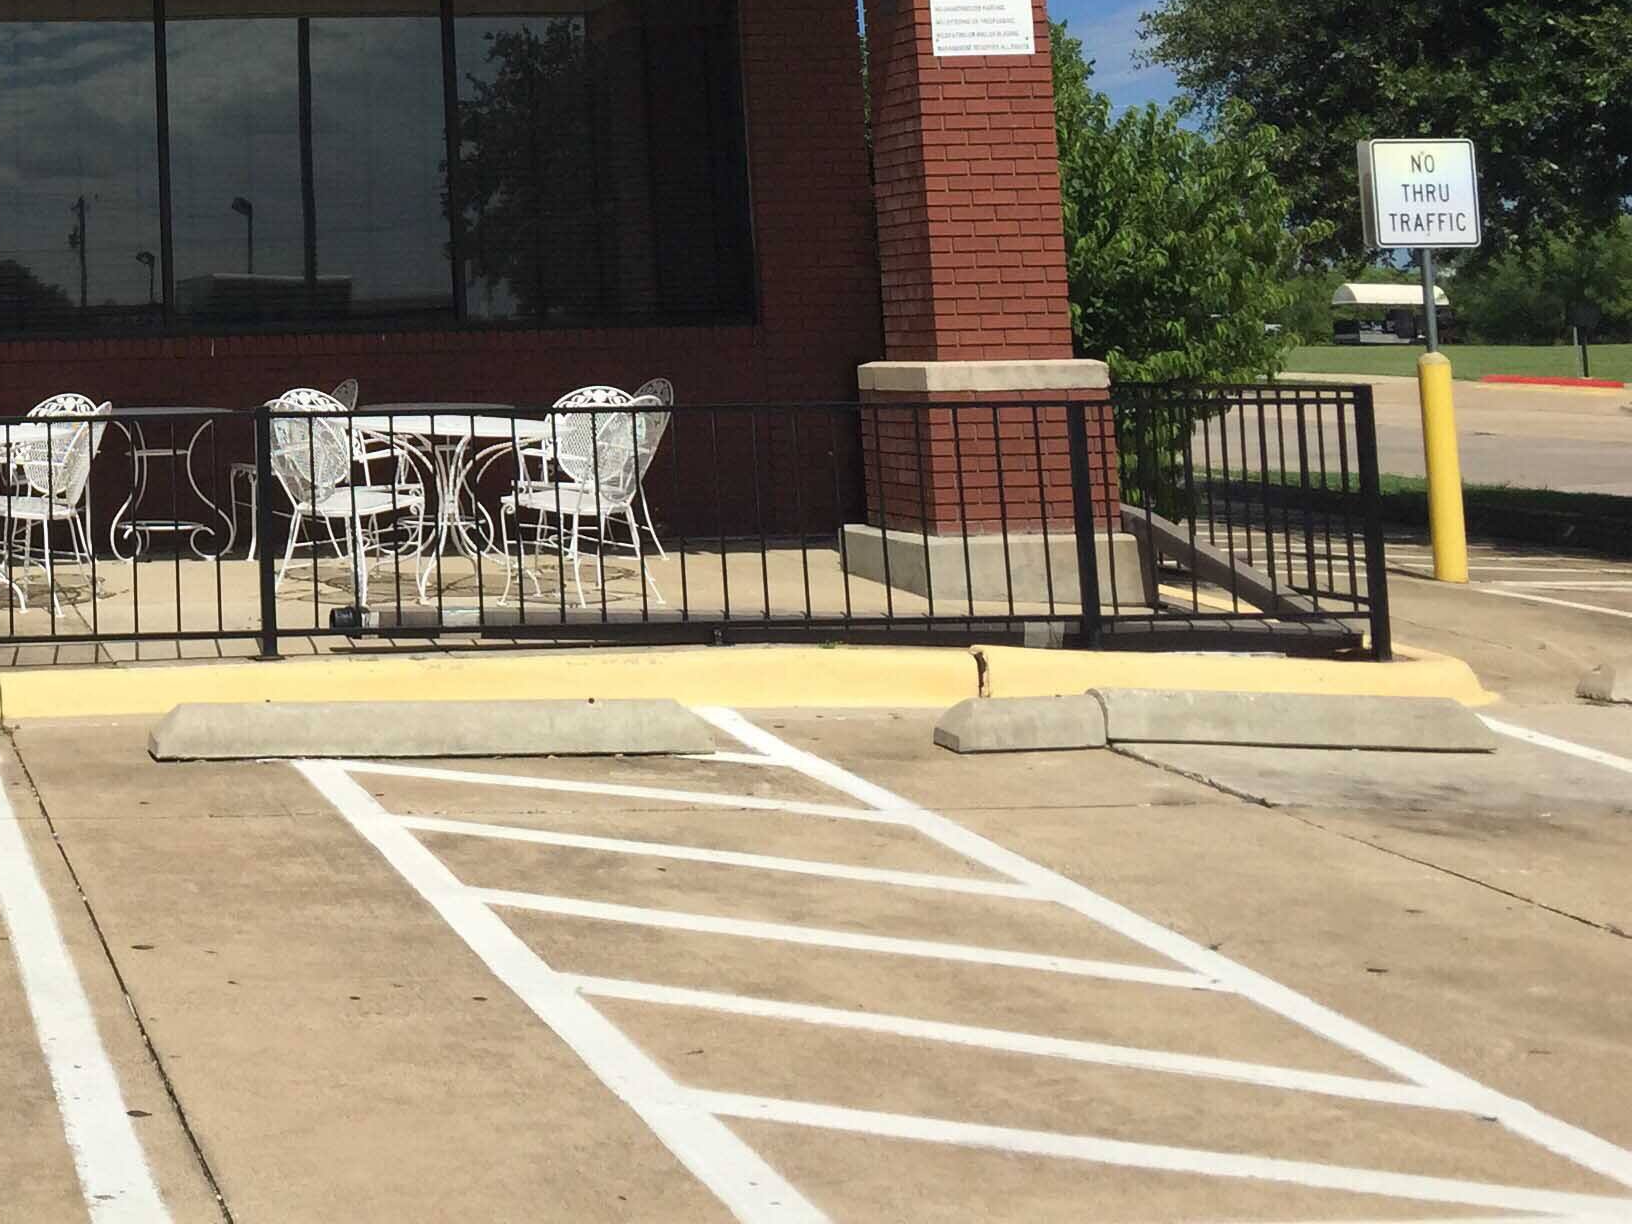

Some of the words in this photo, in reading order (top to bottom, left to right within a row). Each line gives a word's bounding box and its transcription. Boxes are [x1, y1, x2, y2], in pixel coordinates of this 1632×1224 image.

[1410, 154, 1435, 173] NO
[1401, 183, 1450, 202] THRU
[1388, 212, 1467, 232] TRAFFIC
